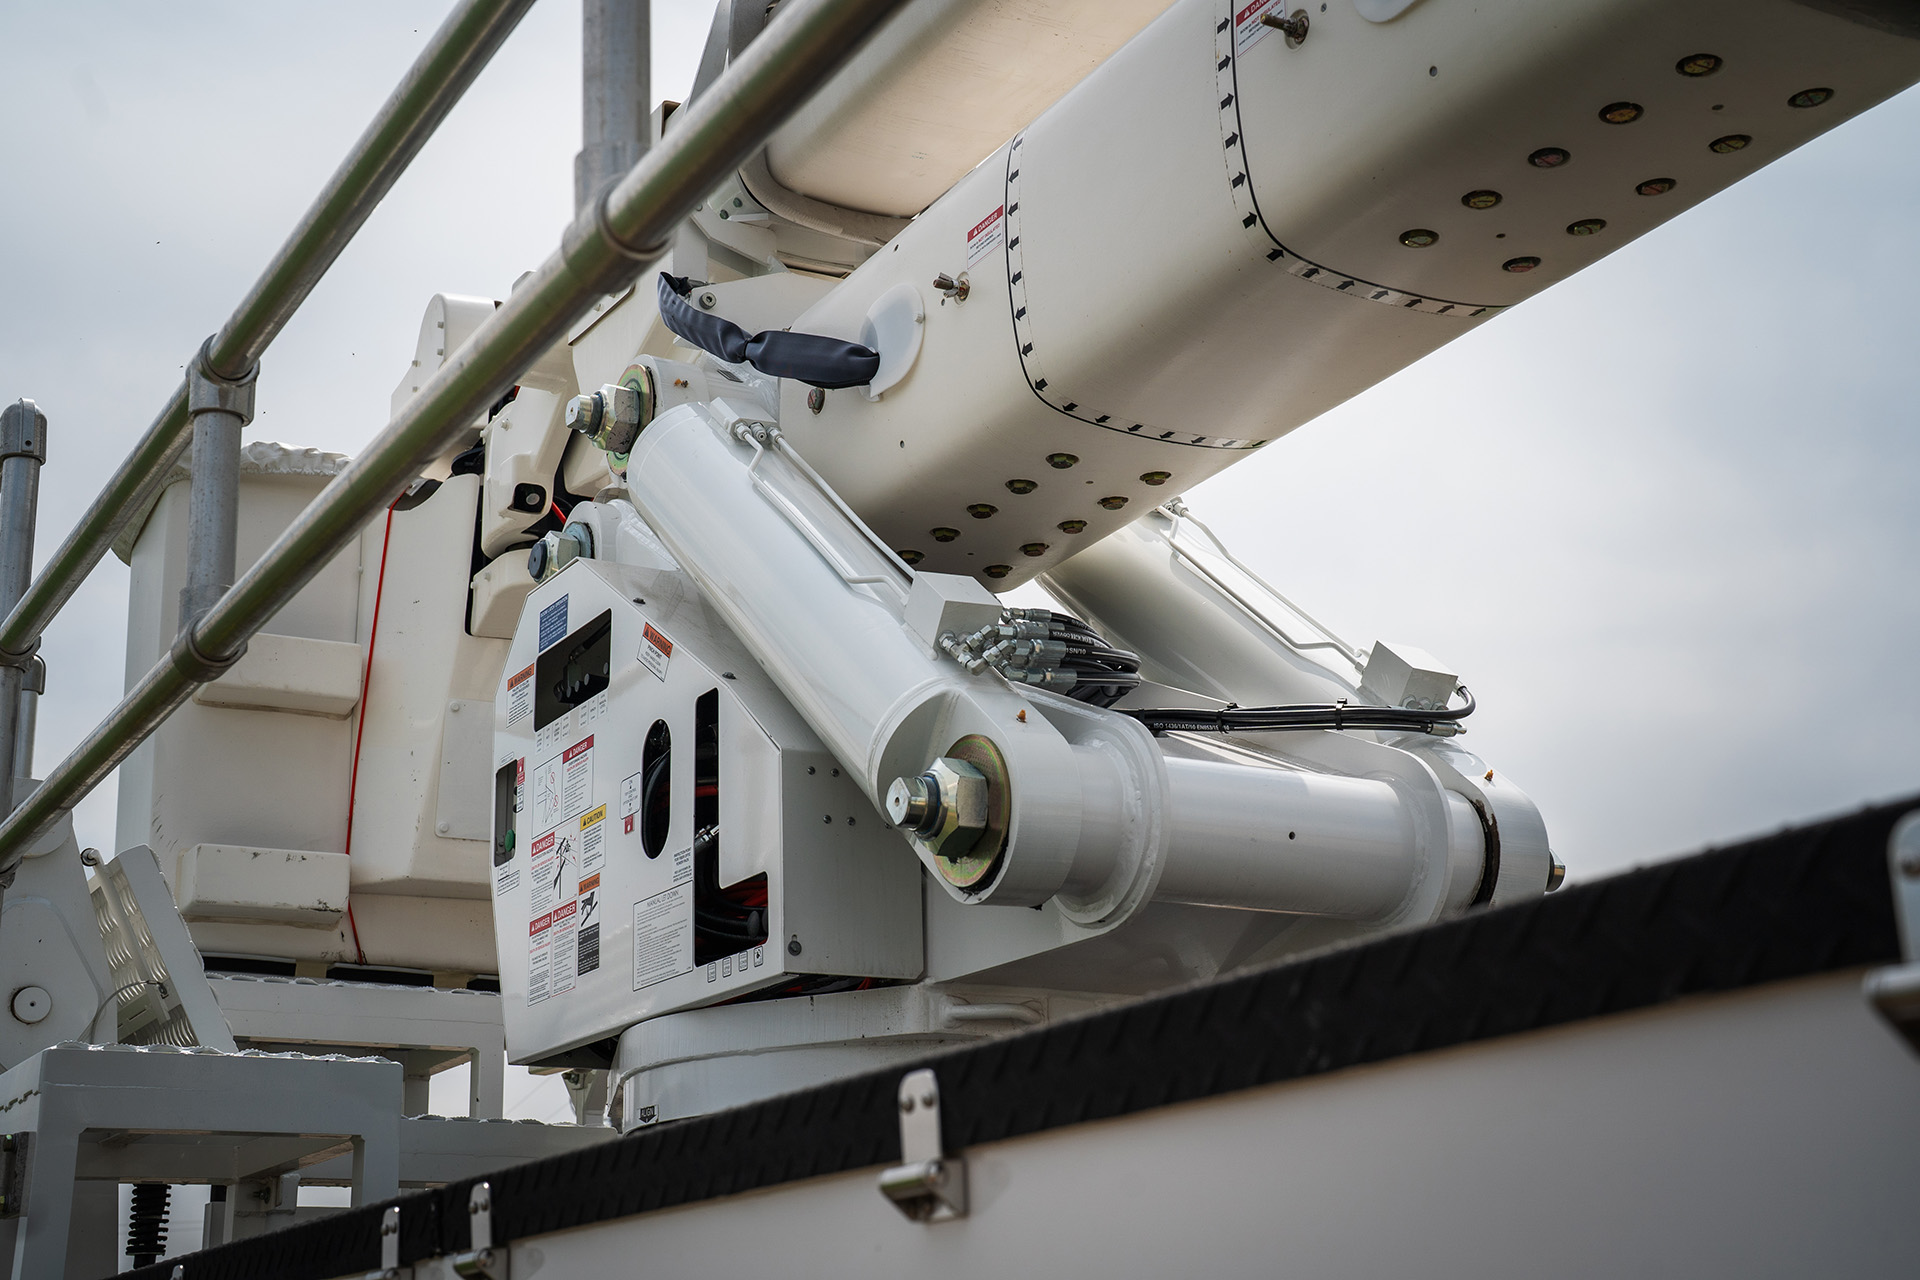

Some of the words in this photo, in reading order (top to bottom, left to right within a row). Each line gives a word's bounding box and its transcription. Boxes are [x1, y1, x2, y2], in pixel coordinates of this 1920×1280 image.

[978, 213, 998, 232] DANGER
[650, 630, 671, 655] WARNING
[514, 667, 532, 685] WARNING
[573, 741, 588, 756] DANGER
[587, 810, 603, 824] CAUTION
[535, 835, 553, 852] DANGER
[584, 877, 599, 889] WARNING
[557, 903, 575, 919] DANGER
[535, 917, 550, 931] DANGER
